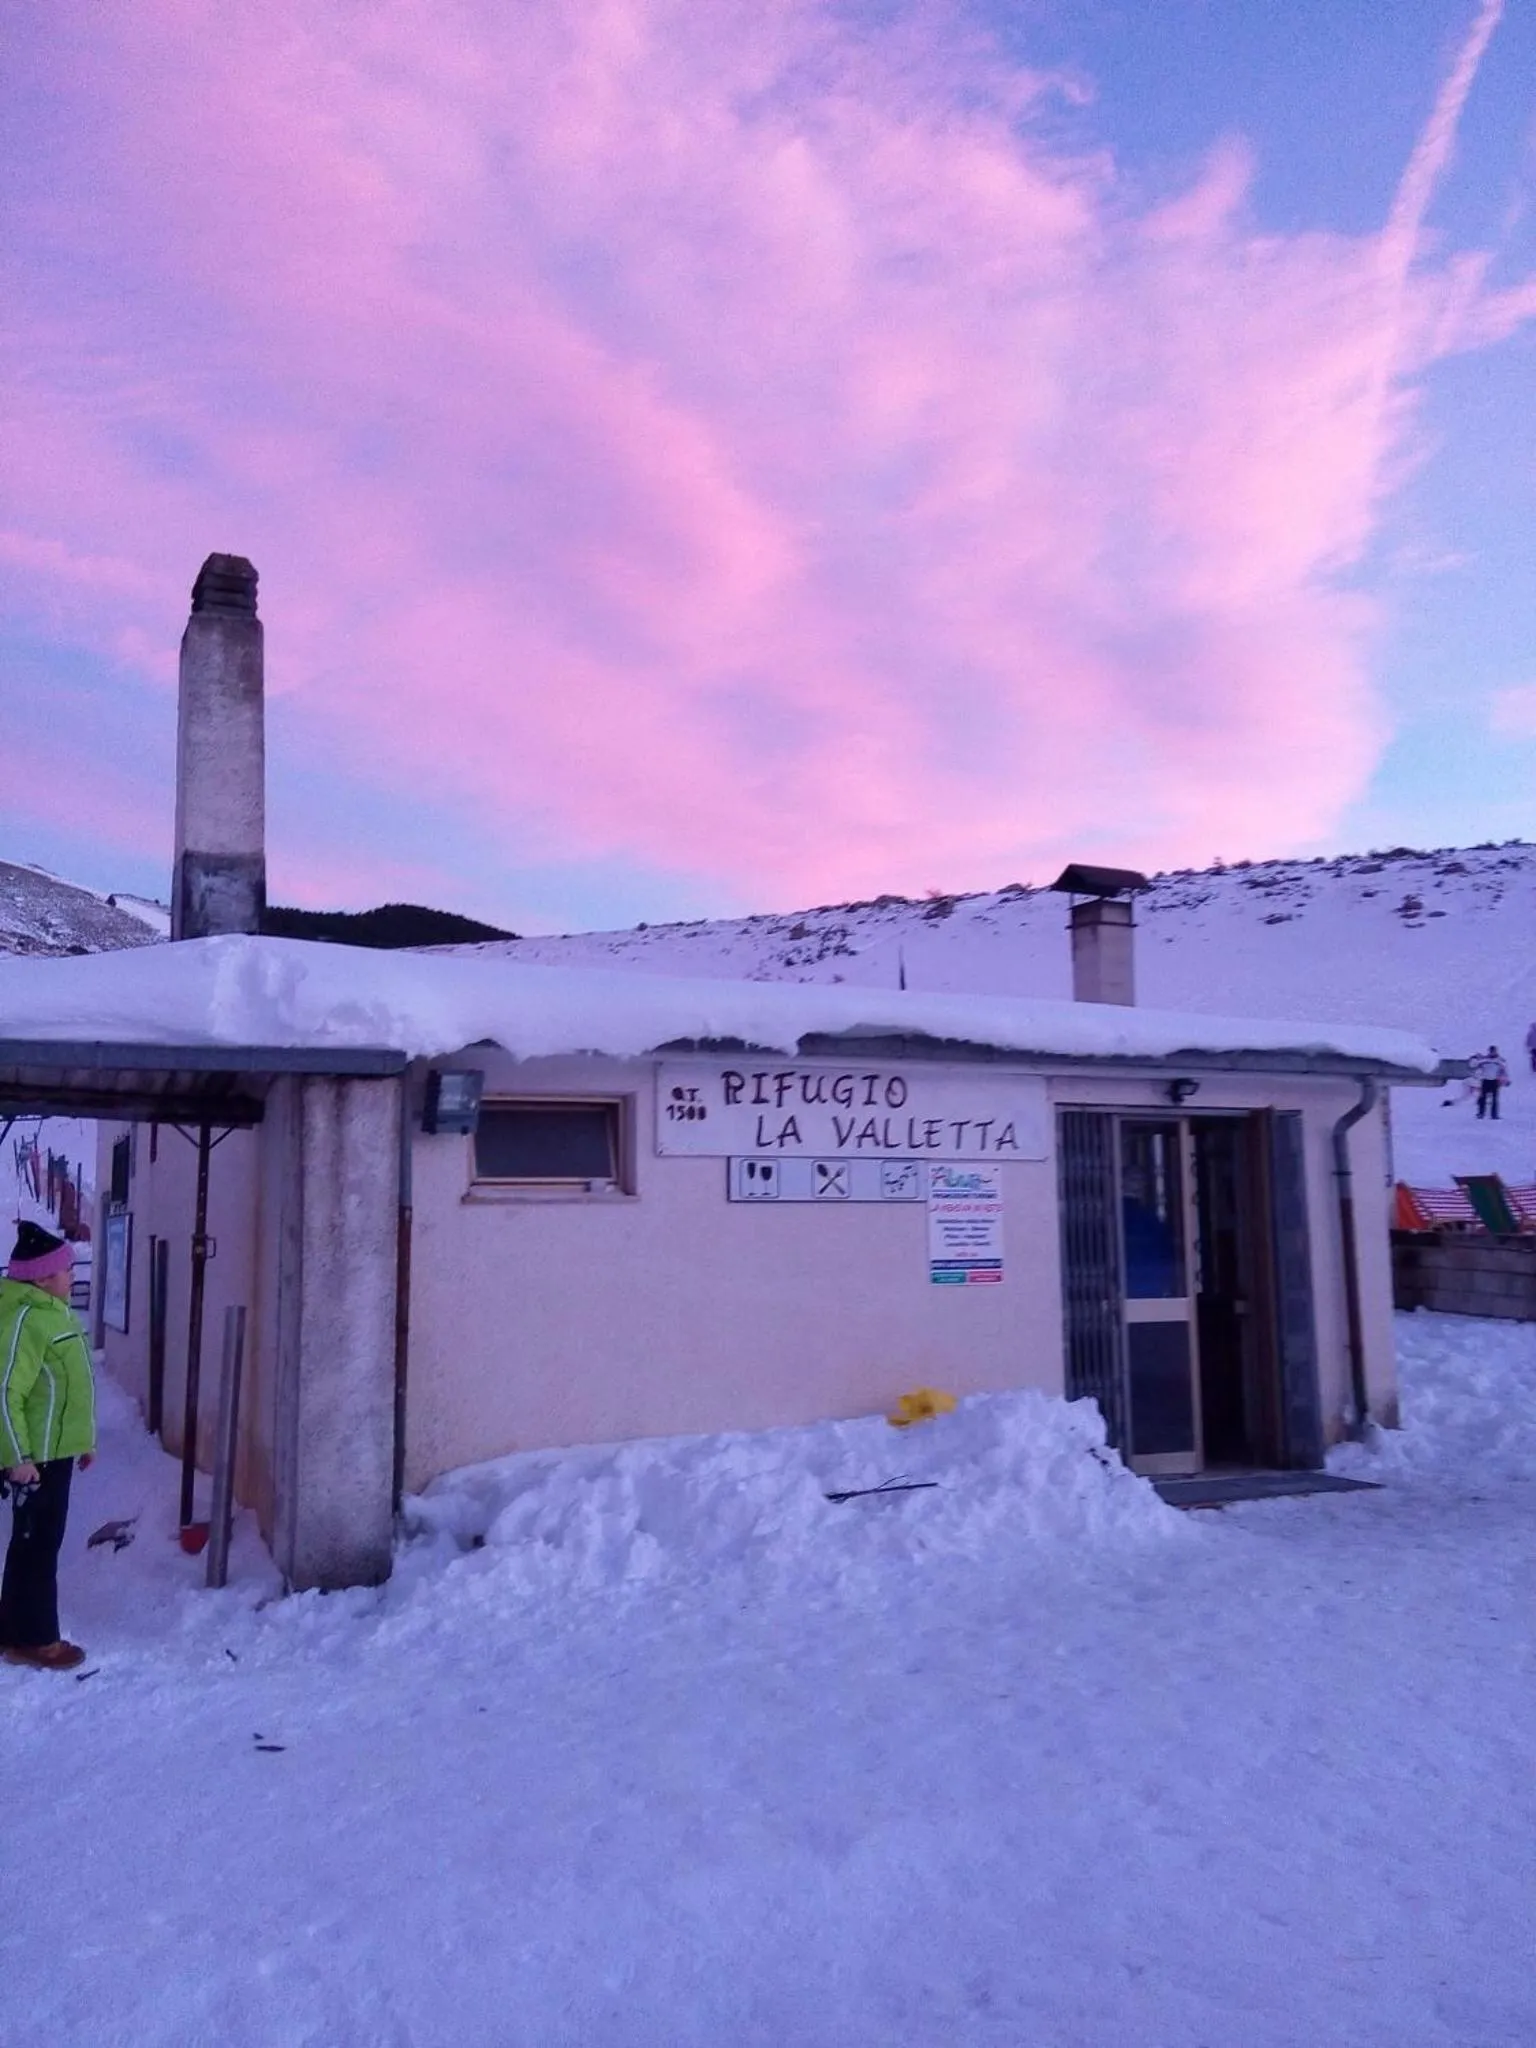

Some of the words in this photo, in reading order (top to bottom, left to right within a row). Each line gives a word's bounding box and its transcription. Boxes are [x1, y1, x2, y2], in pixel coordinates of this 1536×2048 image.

[721, 1070, 908, 1108] RIFUGIO
[755, 1115, 802, 1149] LA
[831, 1116, 1021, 1152] VALLETTA
